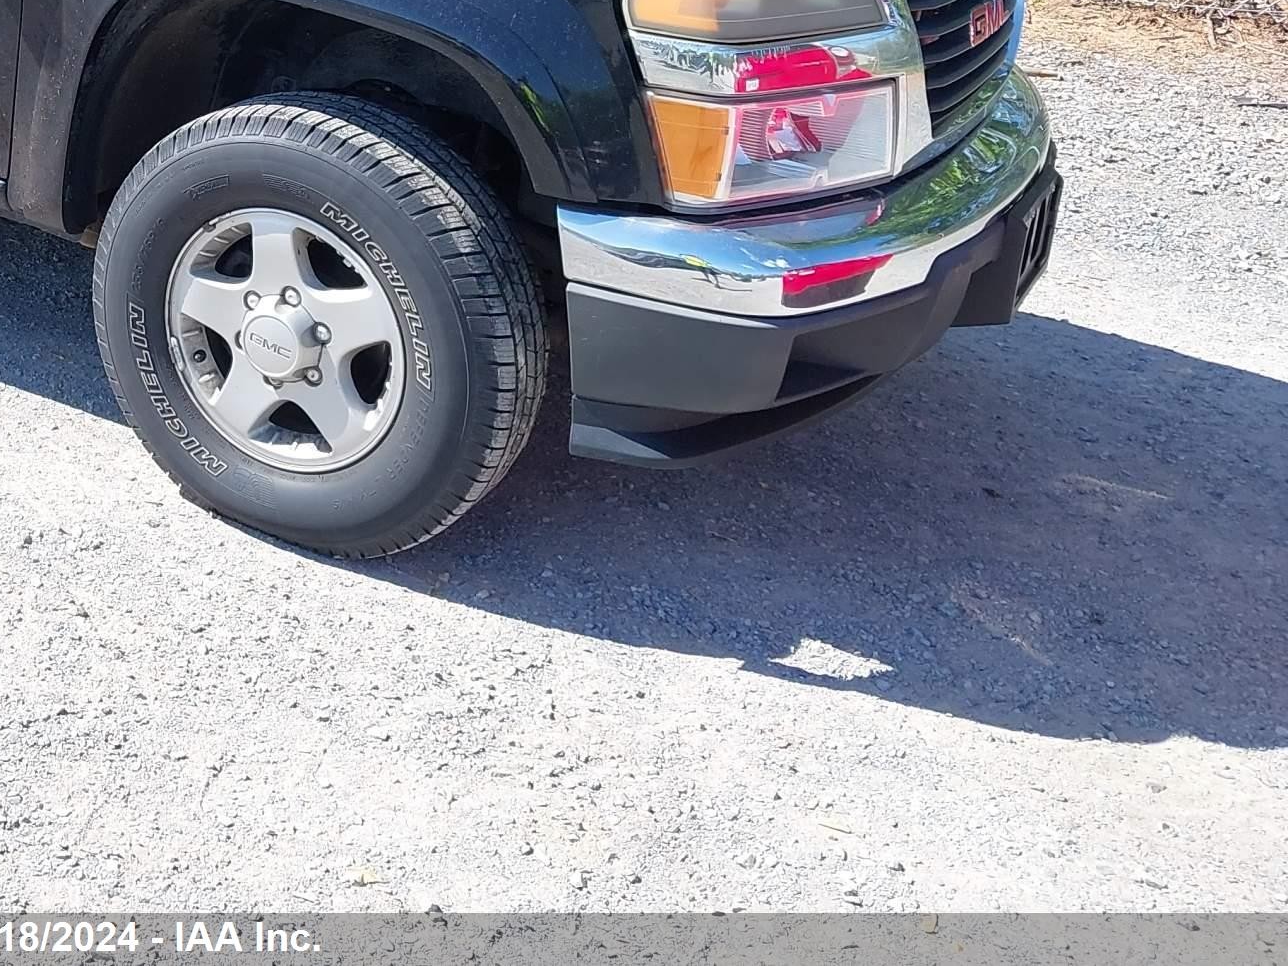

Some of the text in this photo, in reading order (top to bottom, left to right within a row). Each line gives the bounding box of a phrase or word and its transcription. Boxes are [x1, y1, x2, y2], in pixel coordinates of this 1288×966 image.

[249, 332, 293, 360] GMC
[319, 200, 434, 393] MICHELIN
[127, 300, 229, 478] MICHELIN
